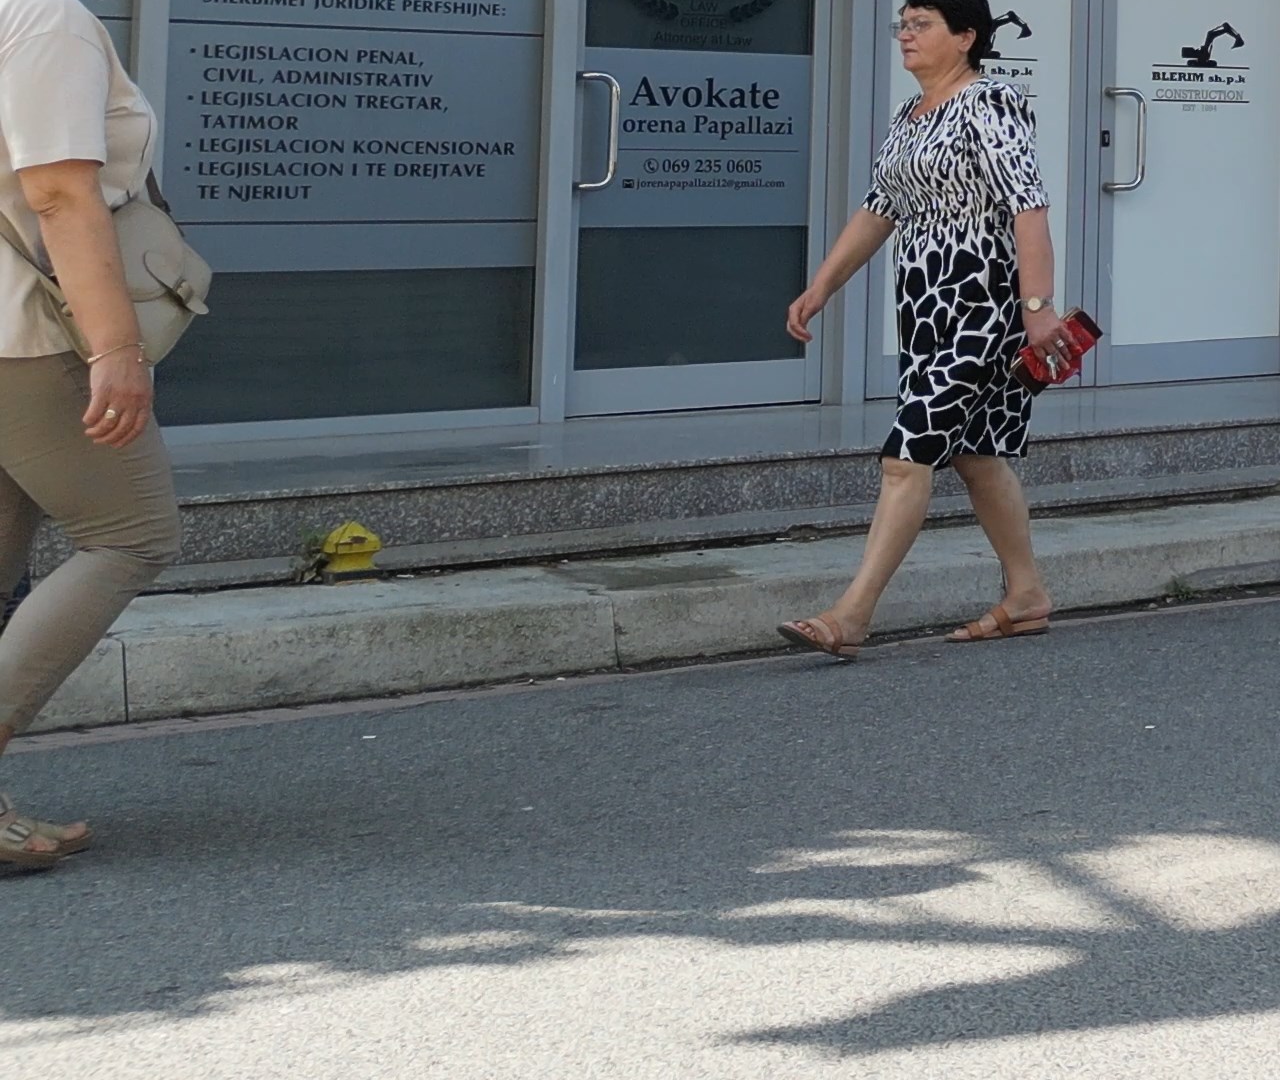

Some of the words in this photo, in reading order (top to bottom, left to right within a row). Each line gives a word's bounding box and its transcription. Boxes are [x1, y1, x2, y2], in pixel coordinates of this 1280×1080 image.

[402, 0, 506, 17] PERFSHIJNE:
[203, 44, 348, 62] LEGJISLACION
[357, 49, 424, 67] PENAL,
[203, 67, 264, 85] CIVIL,
[272, 70, 433, 87] ADMINISTRATIV
[1152, 71, 1204, 82] BLERIM
[629, 76, 780, 109] Avokate
[1155, 88, 1244, 100] CONSTRUCTION
[201, 91, 347, 109] LEGJISLACION
[355, 95, 448, 113] TREGTAR,
[201, 114, 299, 130] TATIMOR
[622, 118, 687, 133] orena
[693, 115, 793, 140] Papallazi
[200, 138, 345, 155] LEGJISLACION
[353, 140, 515, 156] KONCENSIONAR
[198, 161, 344, 179] LEGJISLACION
[352, 163, 357, 176] I
[366, 163, 386, 177] TE
[394, 163, 486, 179] DREJTAVE
[662, 159, 690, 173] 069
[695, 159, 722, 173] 235
[727, 159, 762, 174] 0605
[197, 185, 220, 199] TE
[228, 185, 312, 202] NJERIUT
